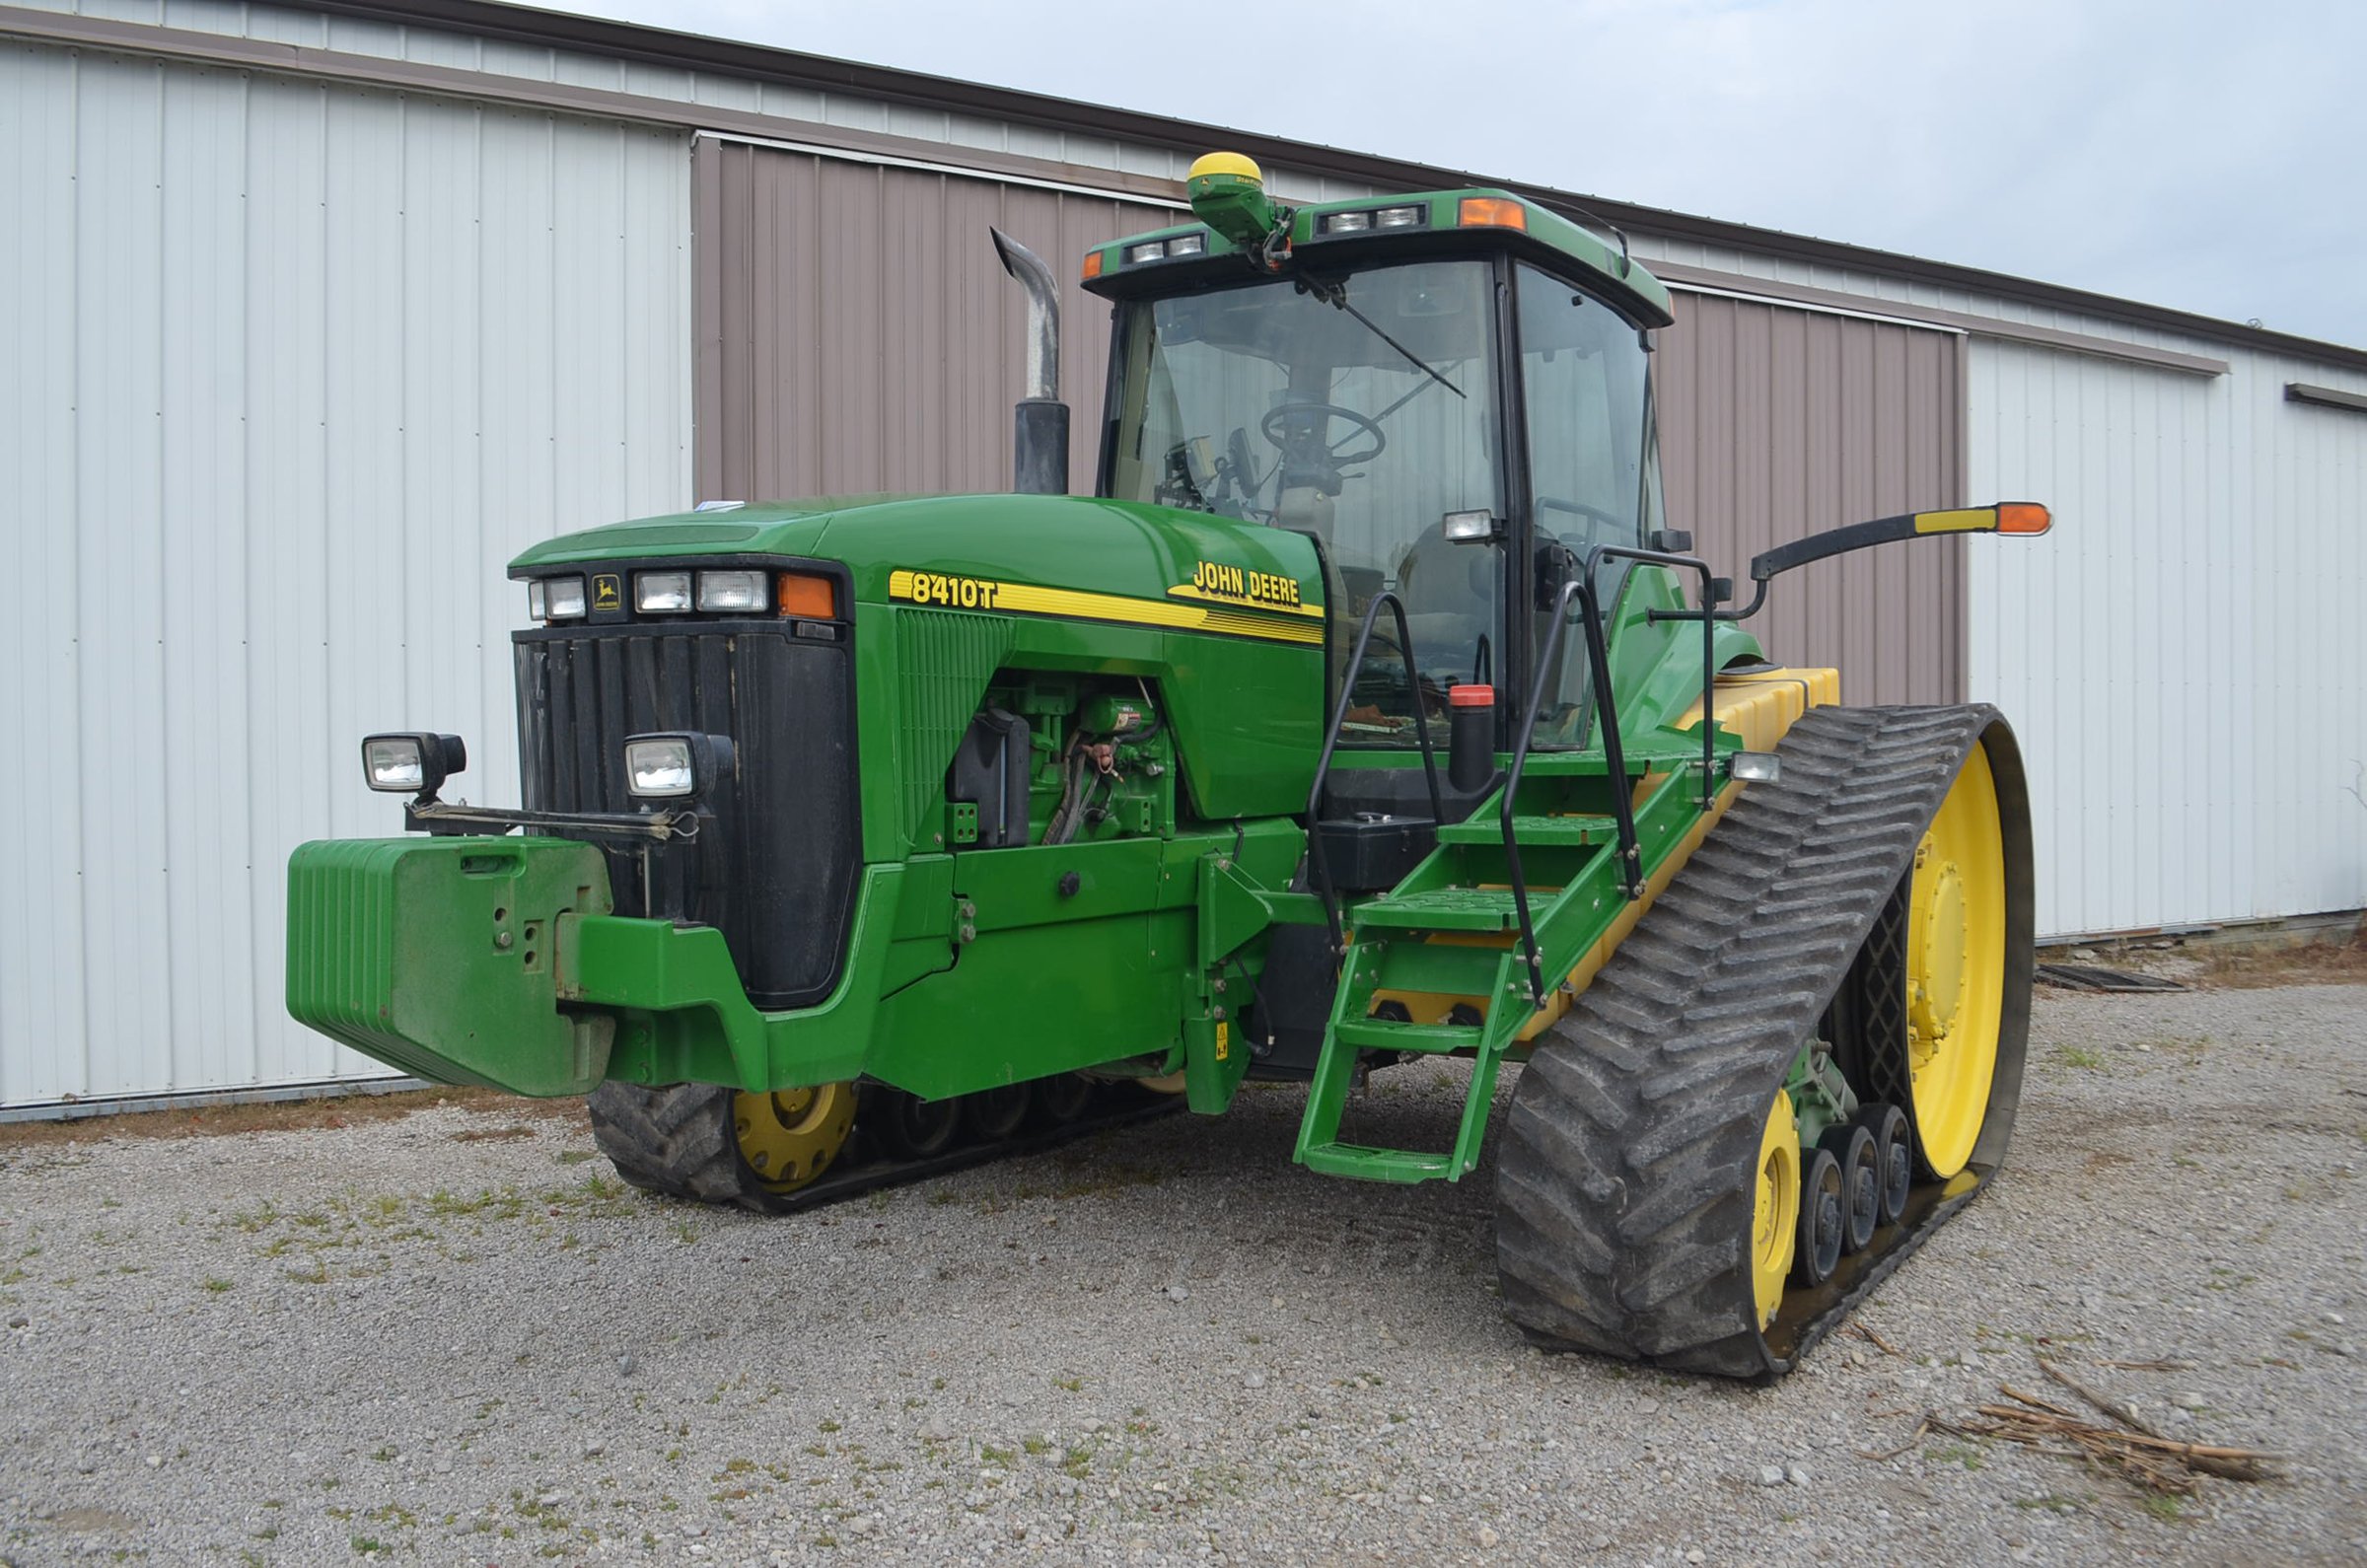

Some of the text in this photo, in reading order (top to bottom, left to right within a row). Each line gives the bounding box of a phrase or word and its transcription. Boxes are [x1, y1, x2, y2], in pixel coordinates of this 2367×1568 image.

[911, 572, 996, 609] 8410T
[1193, 560, 1300, 606] JOHN DEERE
